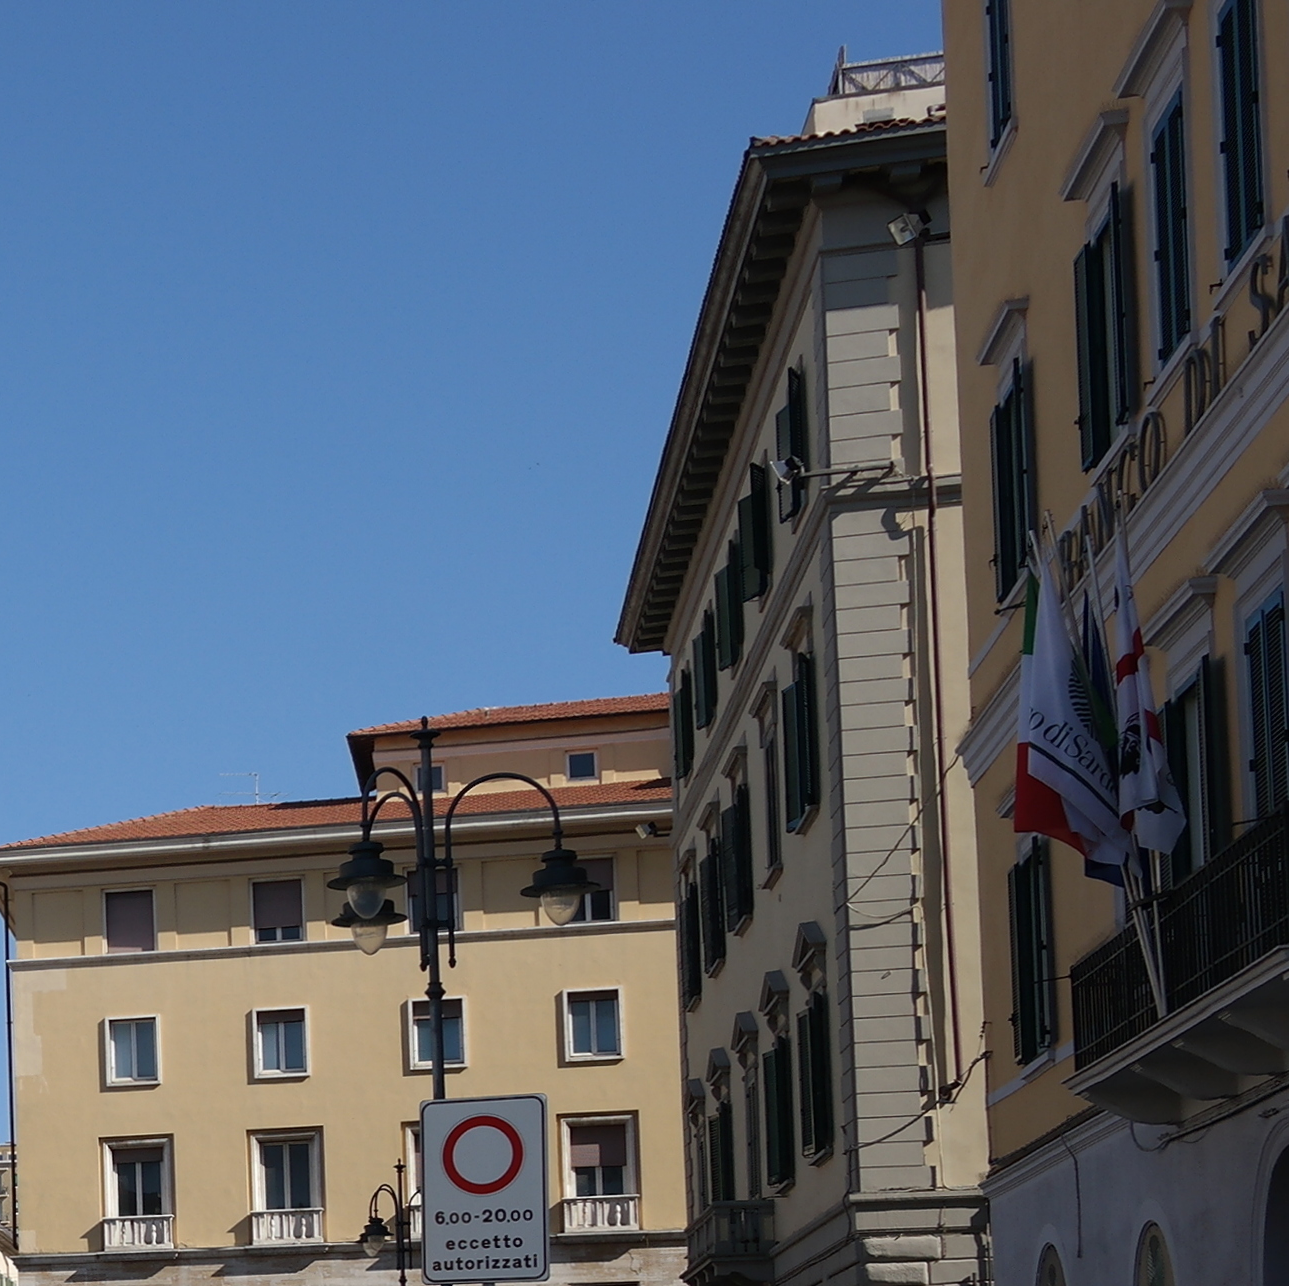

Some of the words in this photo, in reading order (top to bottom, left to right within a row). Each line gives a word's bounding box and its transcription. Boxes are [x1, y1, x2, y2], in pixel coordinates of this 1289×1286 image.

[1185, 314, 1220, 436] DI
[1043, 721, 1074, 749] di
[446, 1235, 524, 1250] eccetto
[433, 1254, 538, 1271] autorizzati
